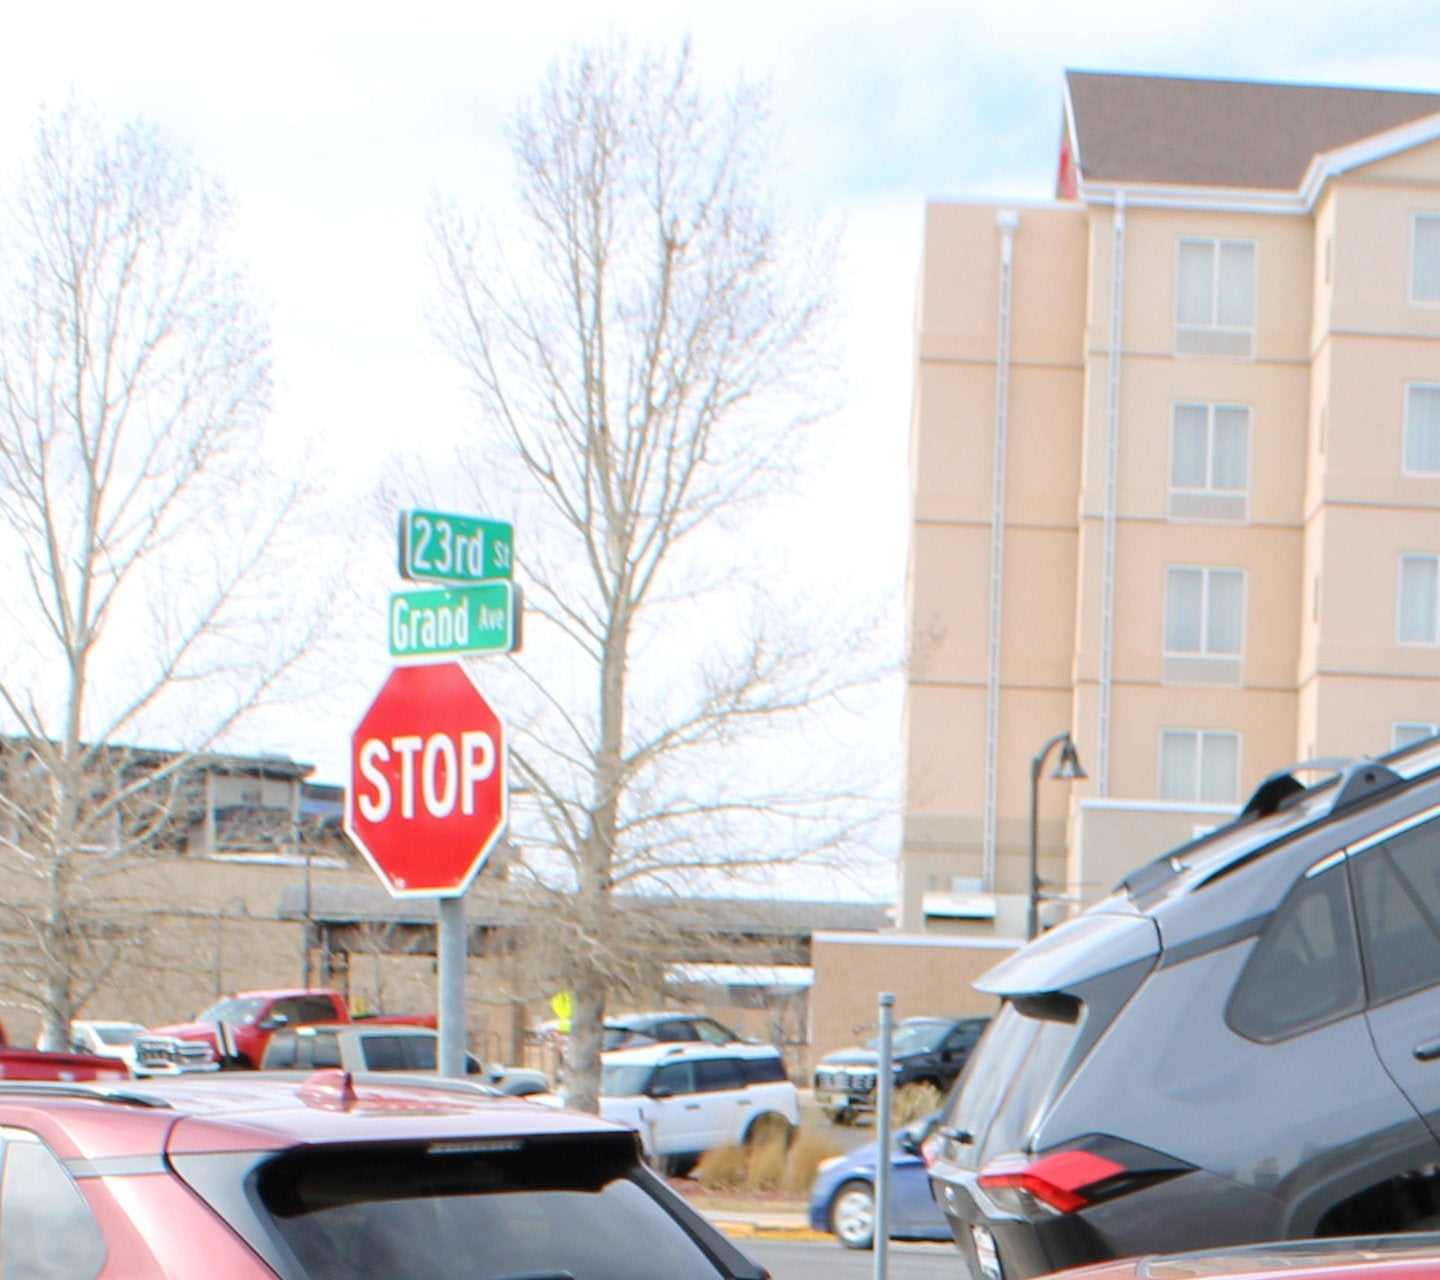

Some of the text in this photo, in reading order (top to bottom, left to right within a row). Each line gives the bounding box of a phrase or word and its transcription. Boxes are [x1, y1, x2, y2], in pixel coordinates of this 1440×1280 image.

[413, 516, 510, 579] 23rd St
[392, 596, 506, 650] Grand Ave
[358, 730, 495, 823] STOP
